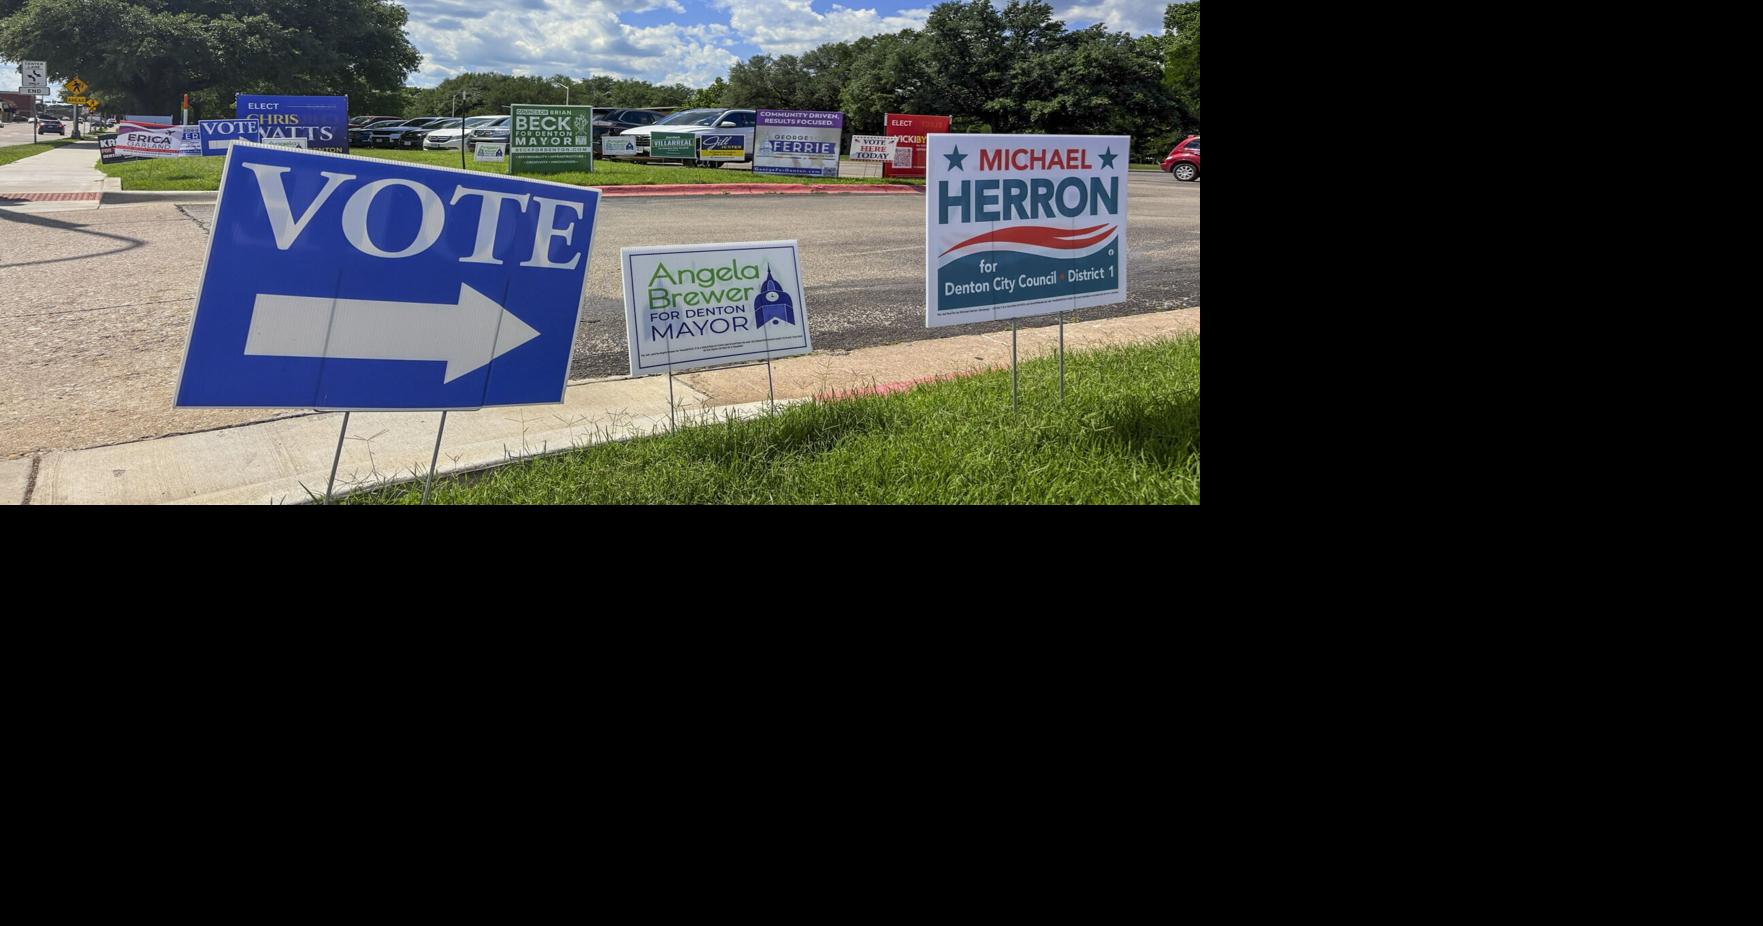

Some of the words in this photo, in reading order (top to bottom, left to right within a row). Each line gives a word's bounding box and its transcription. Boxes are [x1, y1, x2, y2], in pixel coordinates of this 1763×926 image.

[246, 114, 299, 125] CHRIS
[760, 111, 807, 119] COMMUNITY
[202, 121, 259, 135] VOTE
[515, 116, 572, 131] BECK
[127, 141, 171, 149] GARLAND
[128, 133, 171, 145] ERICA
[515, 137, 572, 146] MAYOR
[702, 136, 732, 151] Jill
[894, 135, 927, 144] VICKIBY
[773, 141, 830, 153] FERRIE
[979, 148, 1093, 172] MICHAEL
[938, 176, 1119, 225] HERRON
[242, 161, 586, 270] VOTE
[648, 258, 760, 288] Angela
[979, 259, 998, 274] for
[944, 280, 990, 296] Denton
[993, 277, 1016, 293] City
[1018, 271, 1057, 289] Council
[1067, 267, 1105, 283] District
[1108, 265, 1115, 278] 1
[648, 286, 754, 310] Brewer
[650, 310, 680, 323] FOR
[685, 304, 746, 319] DENTON
[651, 316, 749, 342] MAYOR
